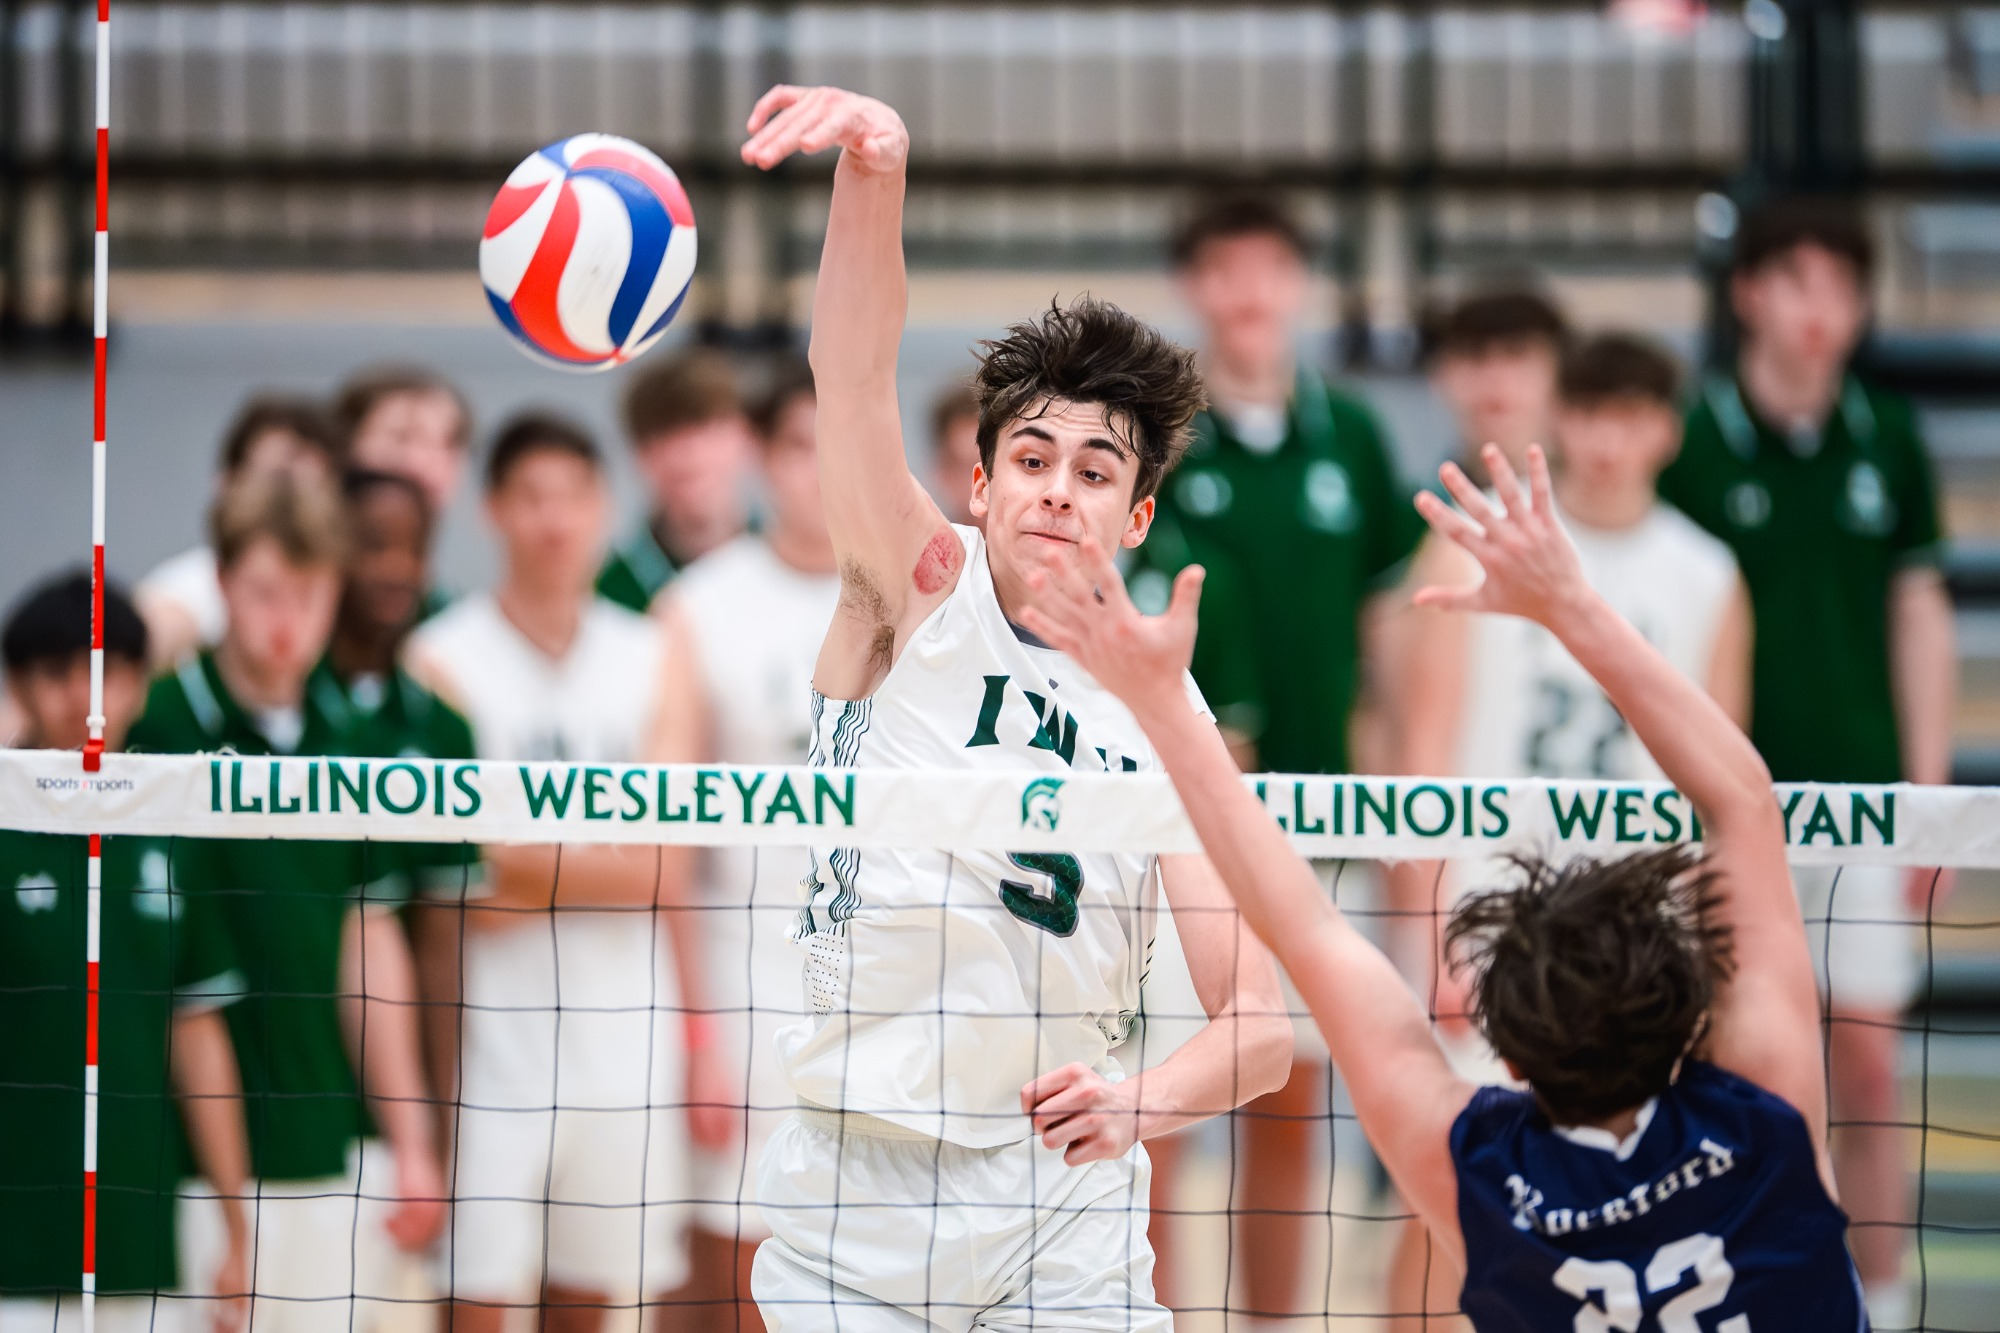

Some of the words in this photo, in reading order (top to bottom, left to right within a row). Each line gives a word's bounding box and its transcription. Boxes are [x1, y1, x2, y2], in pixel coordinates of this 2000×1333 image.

[36, 776, 80, 792] sports
[210, 758, 481, 818] ILLINOIS
[521, 767, 856, 828] WESLEYAN
[1548, 786, 1895, 846] WESYAN
